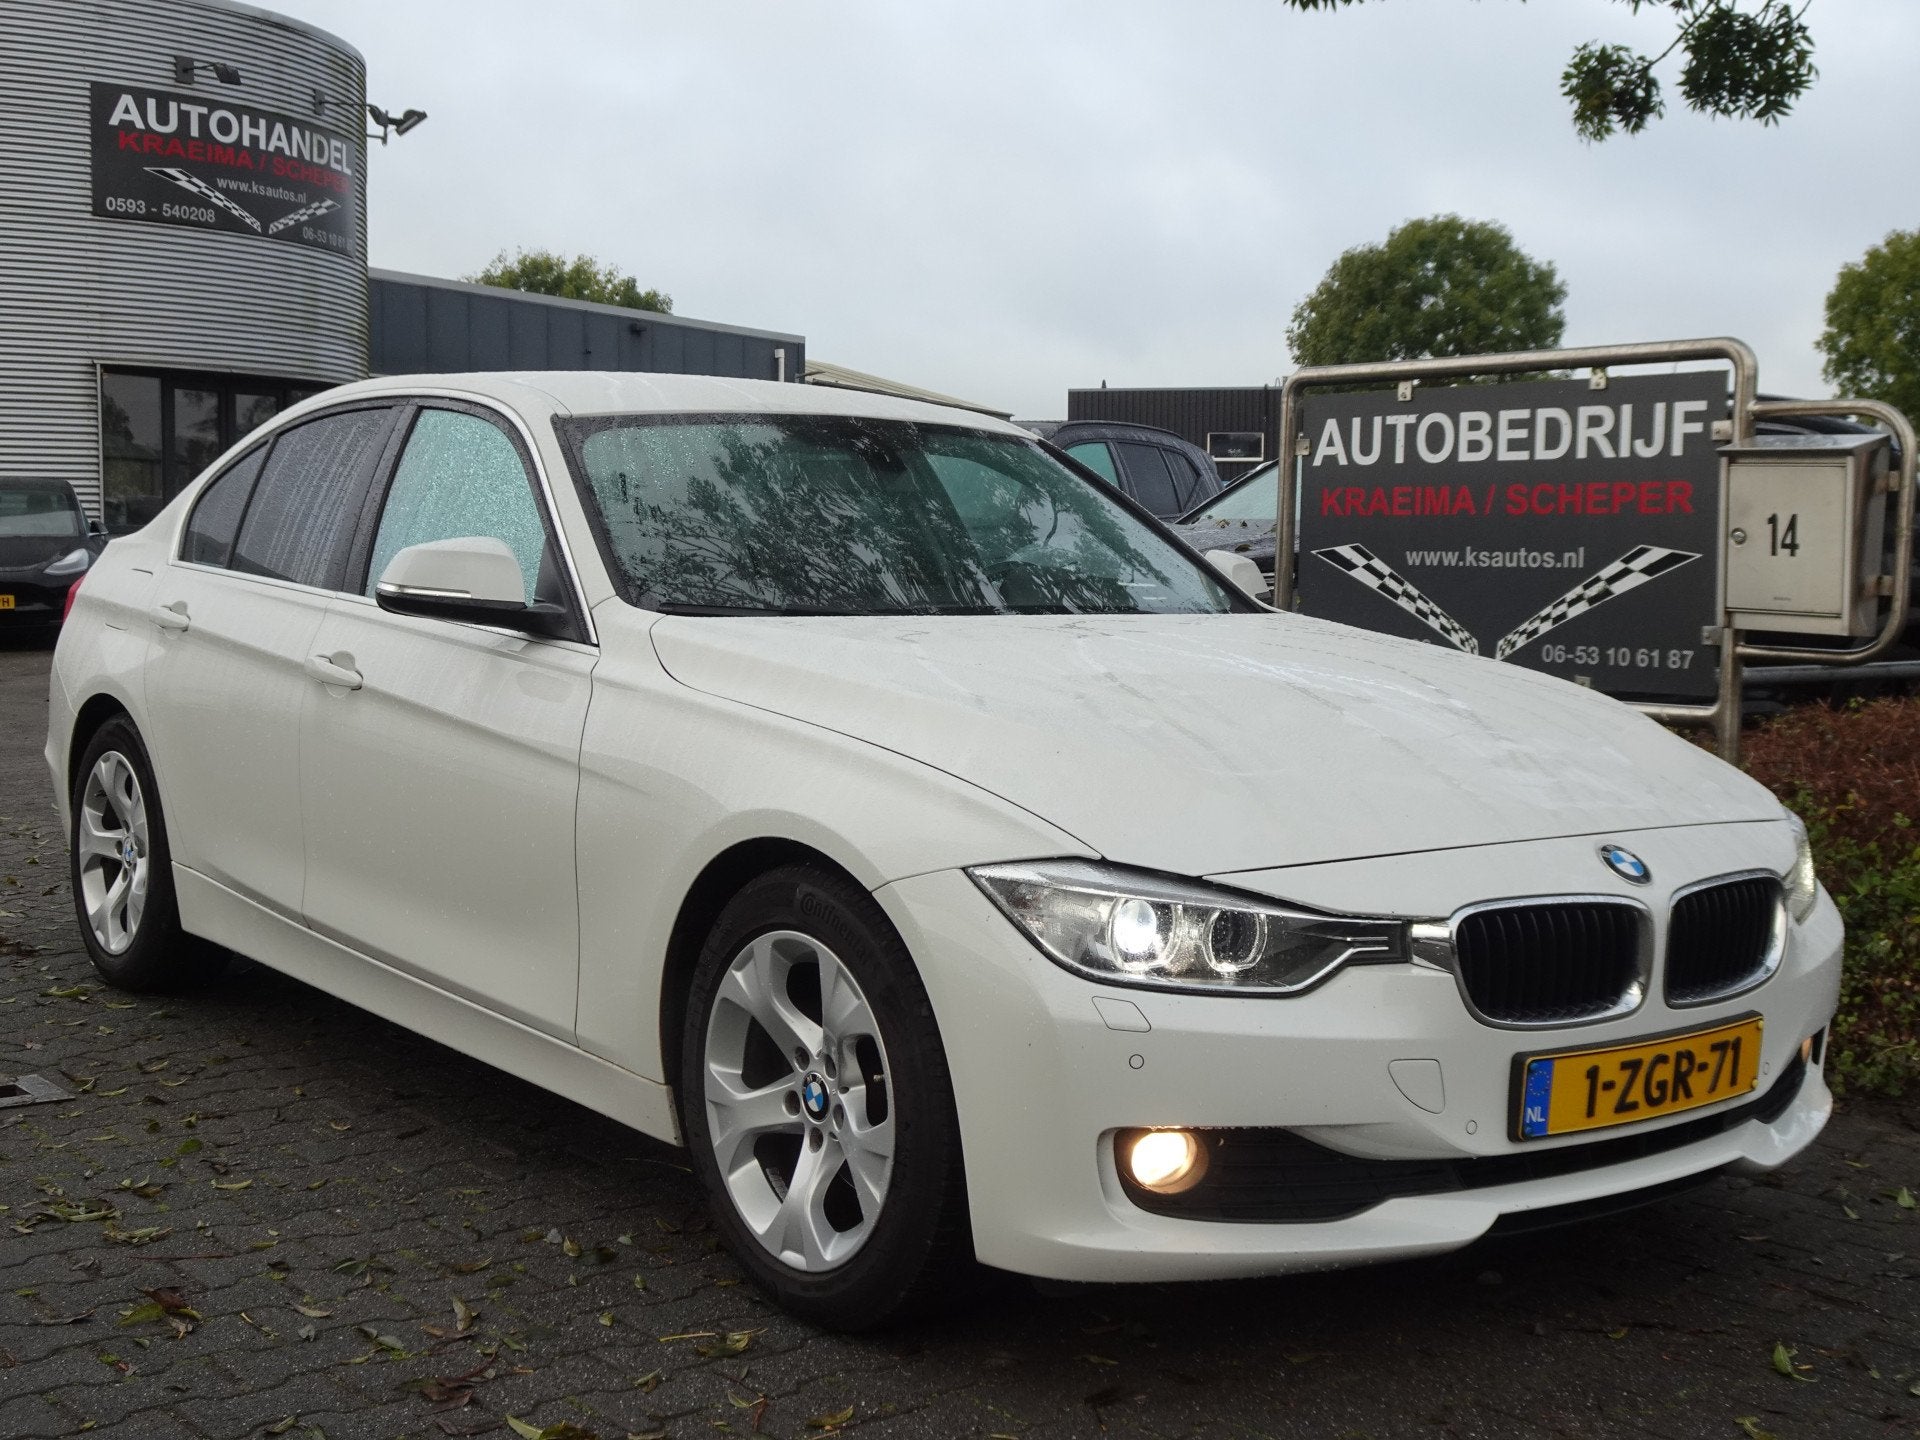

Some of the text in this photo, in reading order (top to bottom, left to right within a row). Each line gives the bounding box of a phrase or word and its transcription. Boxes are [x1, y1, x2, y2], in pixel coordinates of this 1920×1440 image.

[108, 93, 352, 176] AUTOHANDEL
[118, 130, 254, 170] KRAEIMA
[105, 196, 146, 215] 0593
[162, 202, 216, 223] 540208
[216, 177, 307, 204] www.ksautos.nl
[1312, 400, 1708, 466] AUTOBEDRIJF
[1320, 479, 1695, 517] KRAEIMA / SCHEPER
[1767, 512, 1800, 557] 14
[1405, 545, 1586, 569] www.ksautos.nl
[1541, 643, 1695, 670] 06-53 10 61 87
[1585, 1035, 1743, 1119] 1-ZGR-71
[1525, 1106, 1546, 1123] NL
